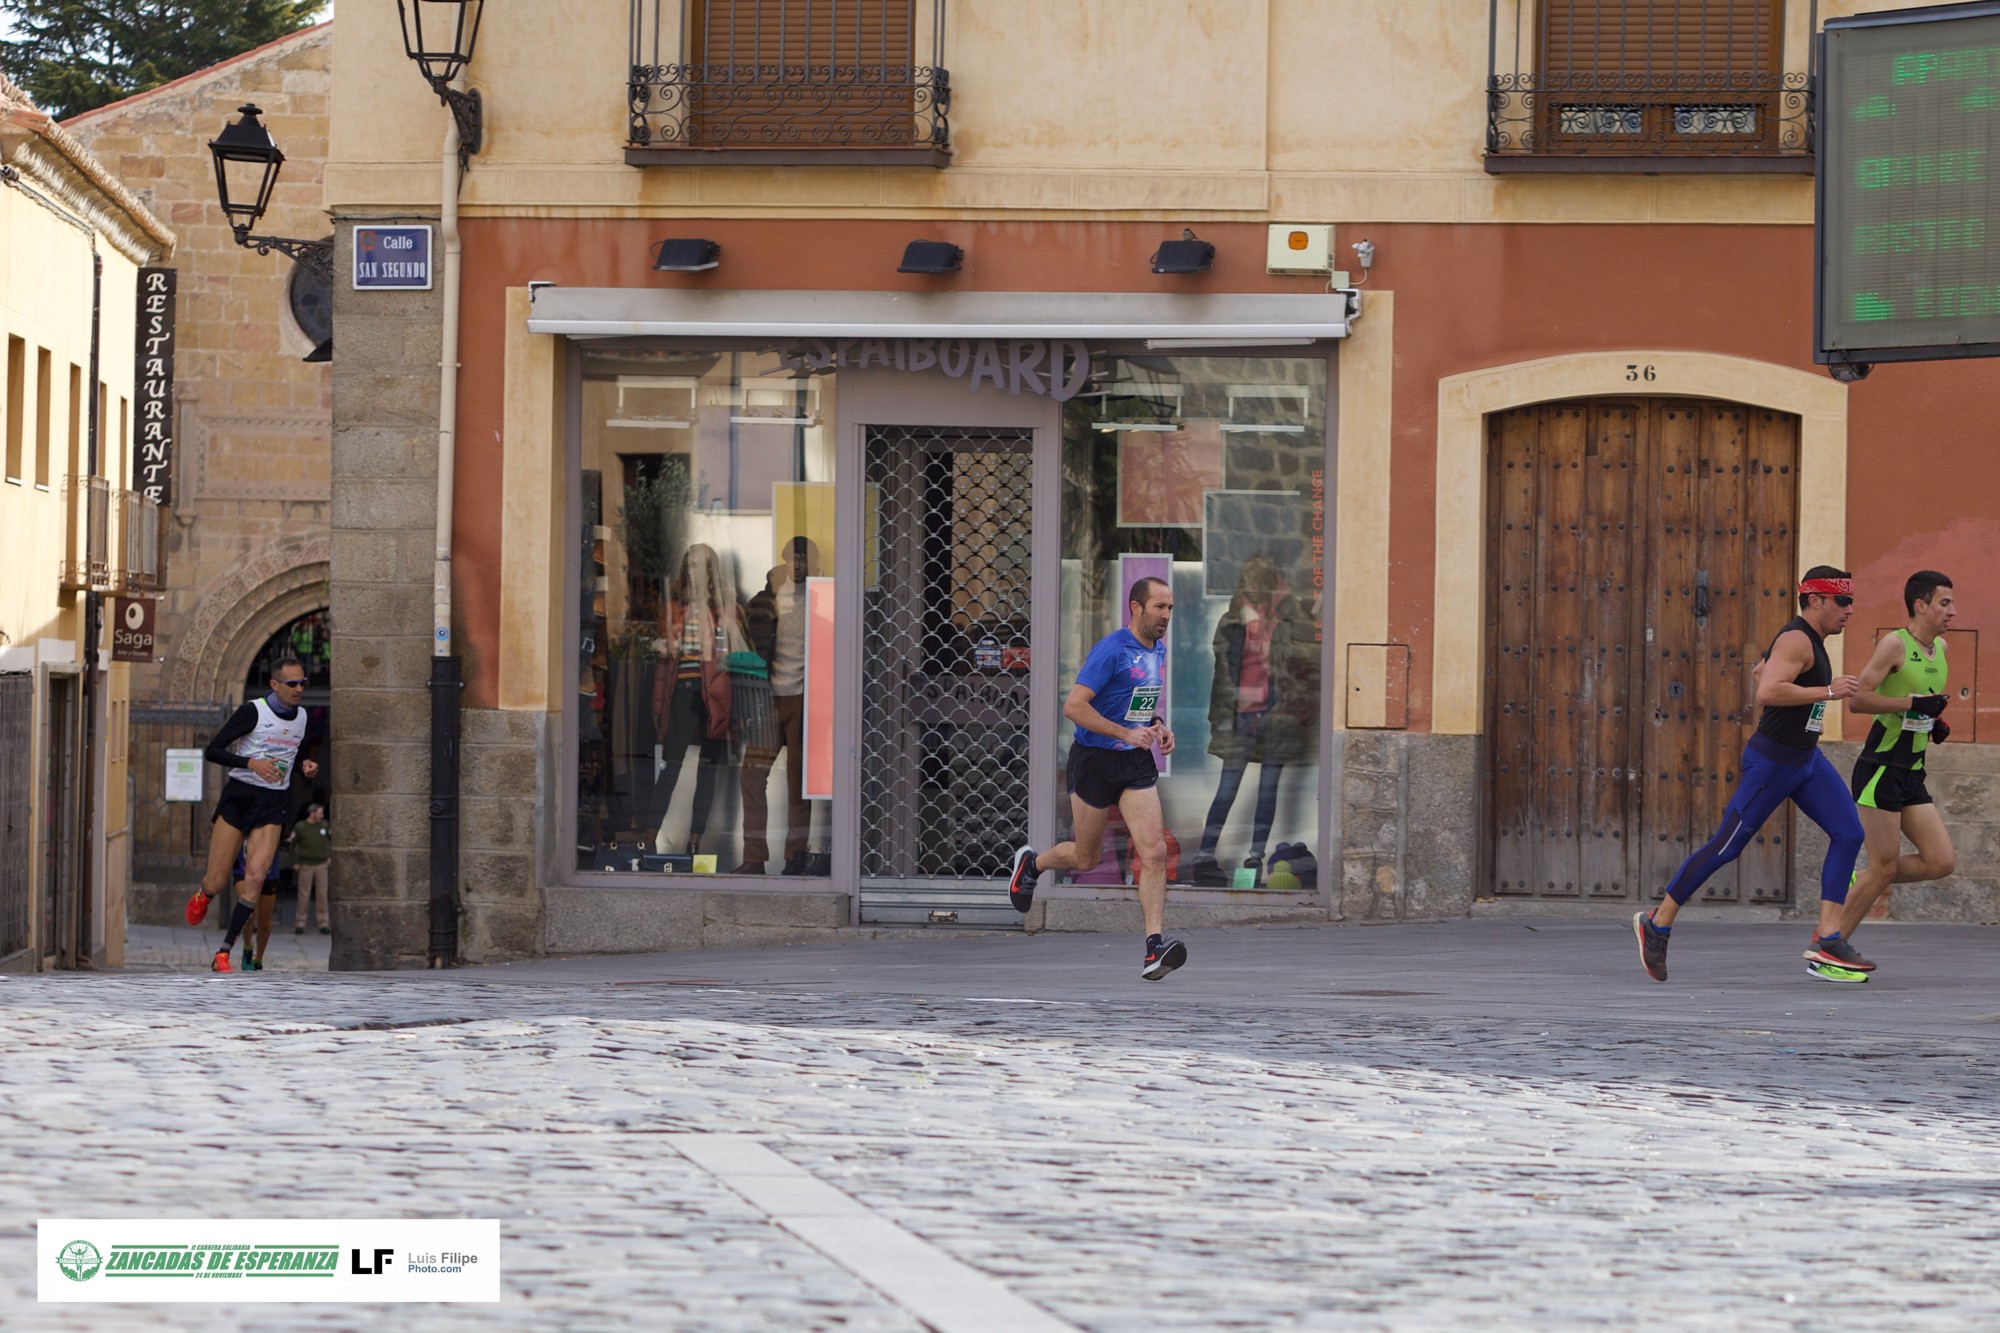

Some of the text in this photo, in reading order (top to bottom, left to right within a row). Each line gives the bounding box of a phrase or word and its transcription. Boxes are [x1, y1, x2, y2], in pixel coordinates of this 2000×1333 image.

[383, 236, 413, 249] Calle
[359, 262, 425, 278] SAN SEGUNDO
[1626, 364, 1657, 382] 36
[142, 272, 171, 504] RESTAURANTE
[1311, 470, 1323, 531] CHANGE
[1312, 535, 1324, 564] THE
[1312, 567, 1324, 587] OF
[115, 629, 152, 649] Saga
[1139, 697, 1155, 710] 22
